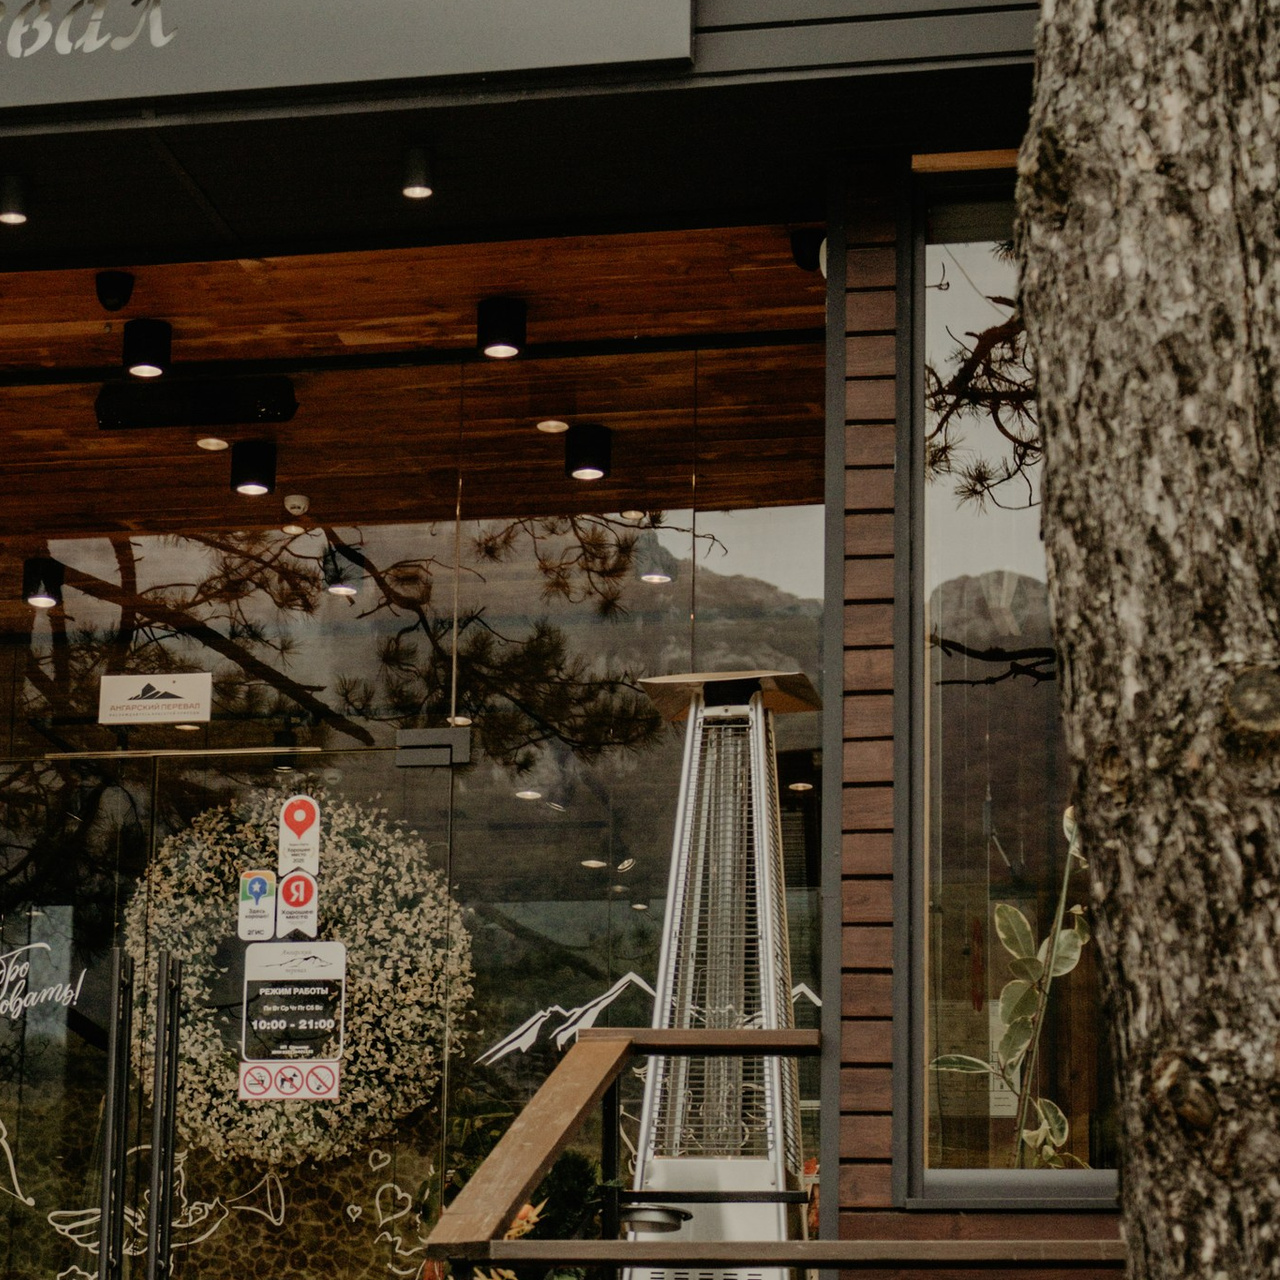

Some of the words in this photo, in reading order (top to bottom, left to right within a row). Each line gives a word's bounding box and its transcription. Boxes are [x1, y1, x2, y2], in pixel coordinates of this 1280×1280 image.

[110, 703, 160, 711] АНГАРСКИЙ
[290, 880, 305, 902] Я
[293, 987, 328, 995] РАБОТЫ
[252, 1020, 287, 1030] 10:00
[298, 1019, 335, 1029] 21:00
